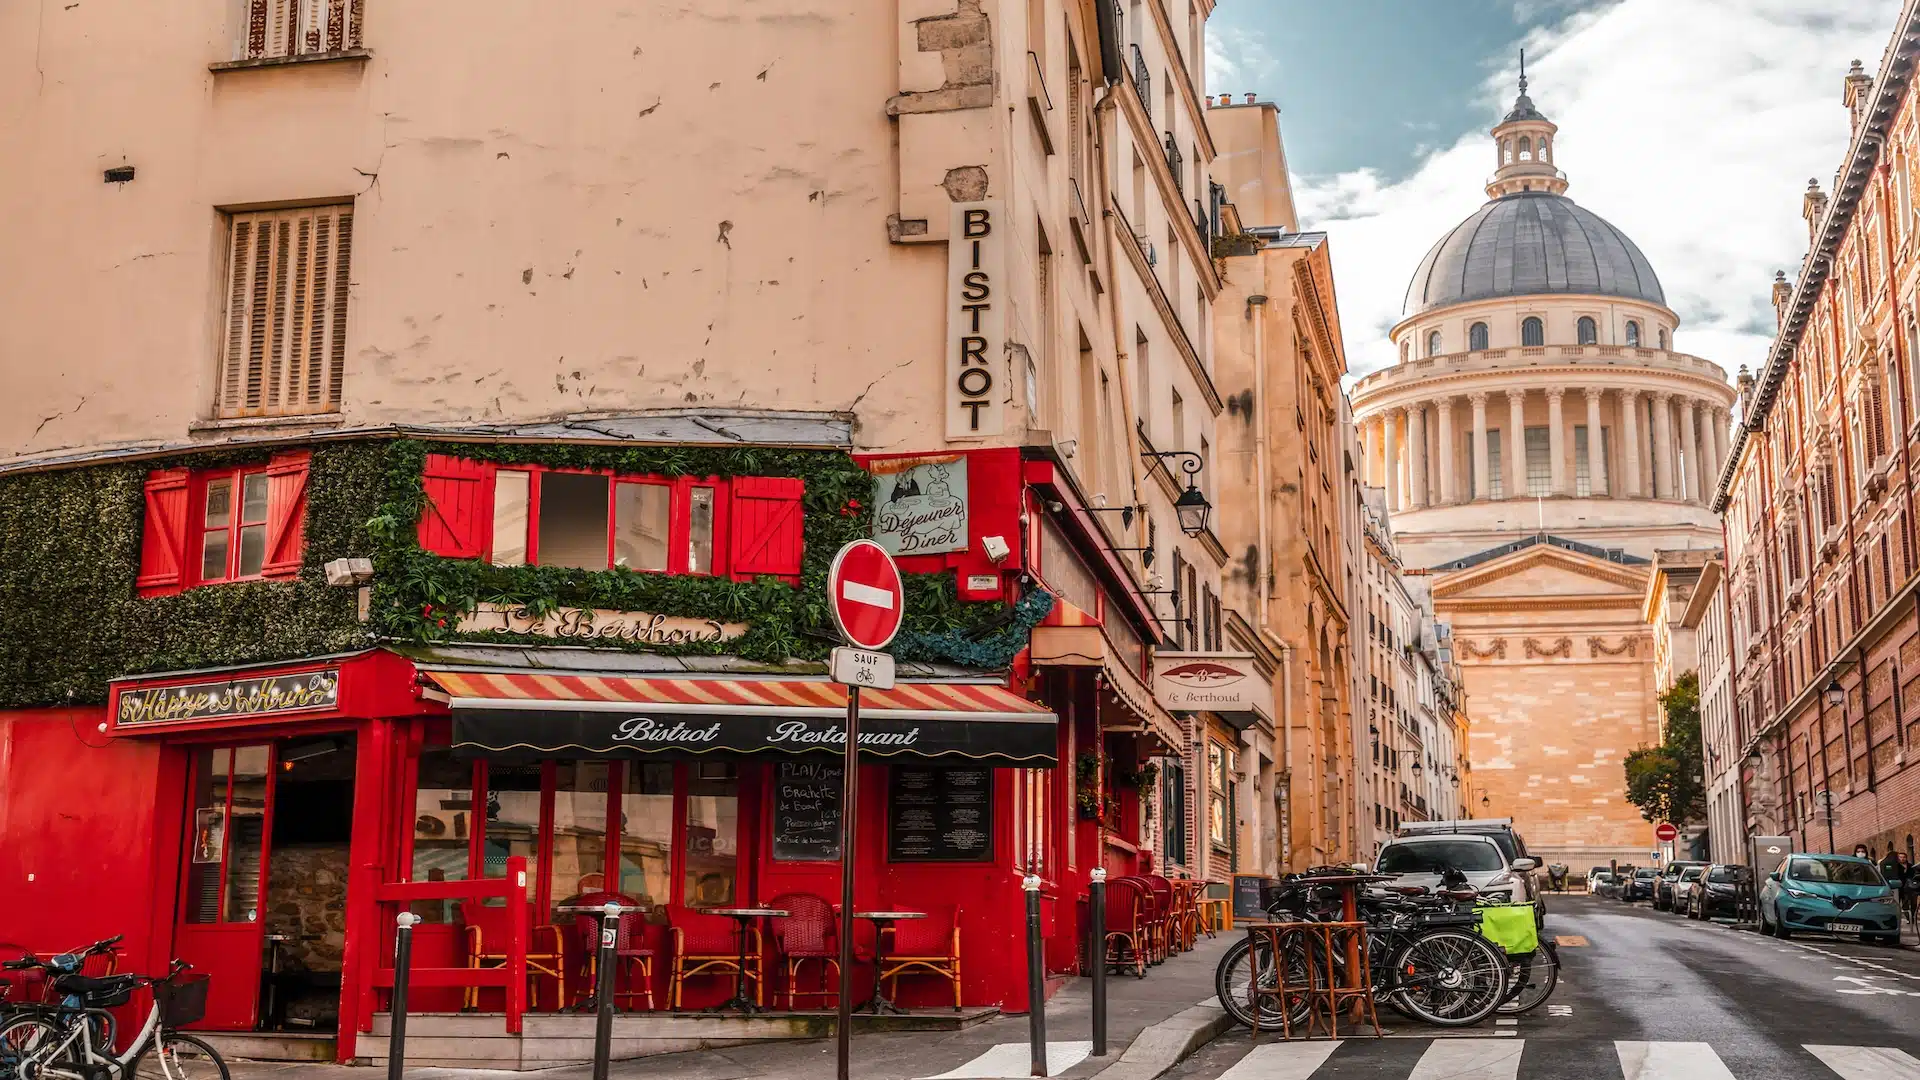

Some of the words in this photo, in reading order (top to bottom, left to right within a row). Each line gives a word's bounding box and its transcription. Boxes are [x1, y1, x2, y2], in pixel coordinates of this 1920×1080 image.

[958, 209, 992, 431] BISTROT
[880, 502, 963, 537] Déjeuner
[555, 608, 725, 643] Berthoud
[854, 653, 878, 665] SAUF
[1186, 692, 1240, 702] Berthoud
[612, 717, 722, 742] Bistrot
